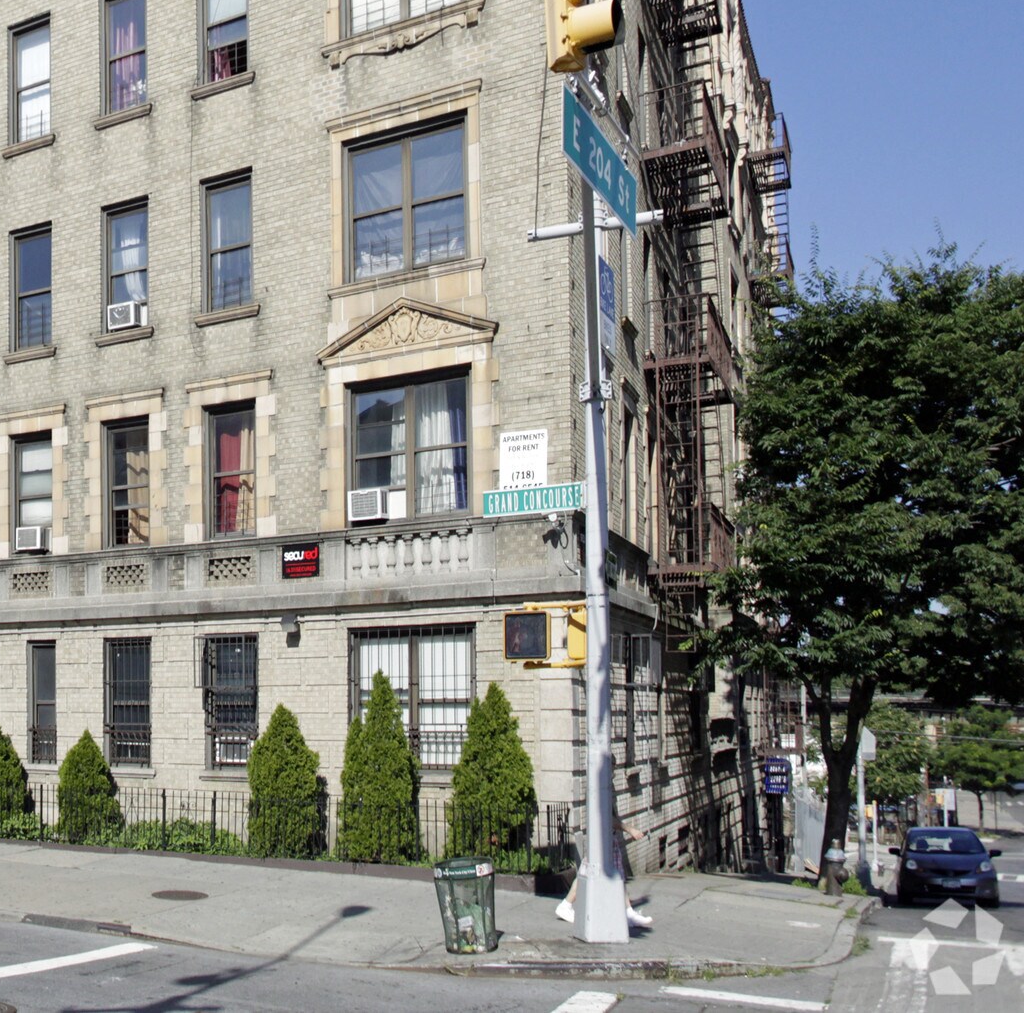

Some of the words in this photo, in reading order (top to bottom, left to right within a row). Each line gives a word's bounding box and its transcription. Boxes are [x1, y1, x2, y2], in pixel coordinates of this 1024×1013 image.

[573, 115, 580, 153] E
[588, 137, 612, 191] 204
[618, 175, 630, 214] St
[502, 432, 545, 443] APARTMENTS
[522, 443, 539, 452] RENT
[511, 470, 535, 482] (718)
[488, 492, 519, 514] GRAND
[523, 485, 580, 511] CONCOURSE
[283, 546, 318, 561] secured
